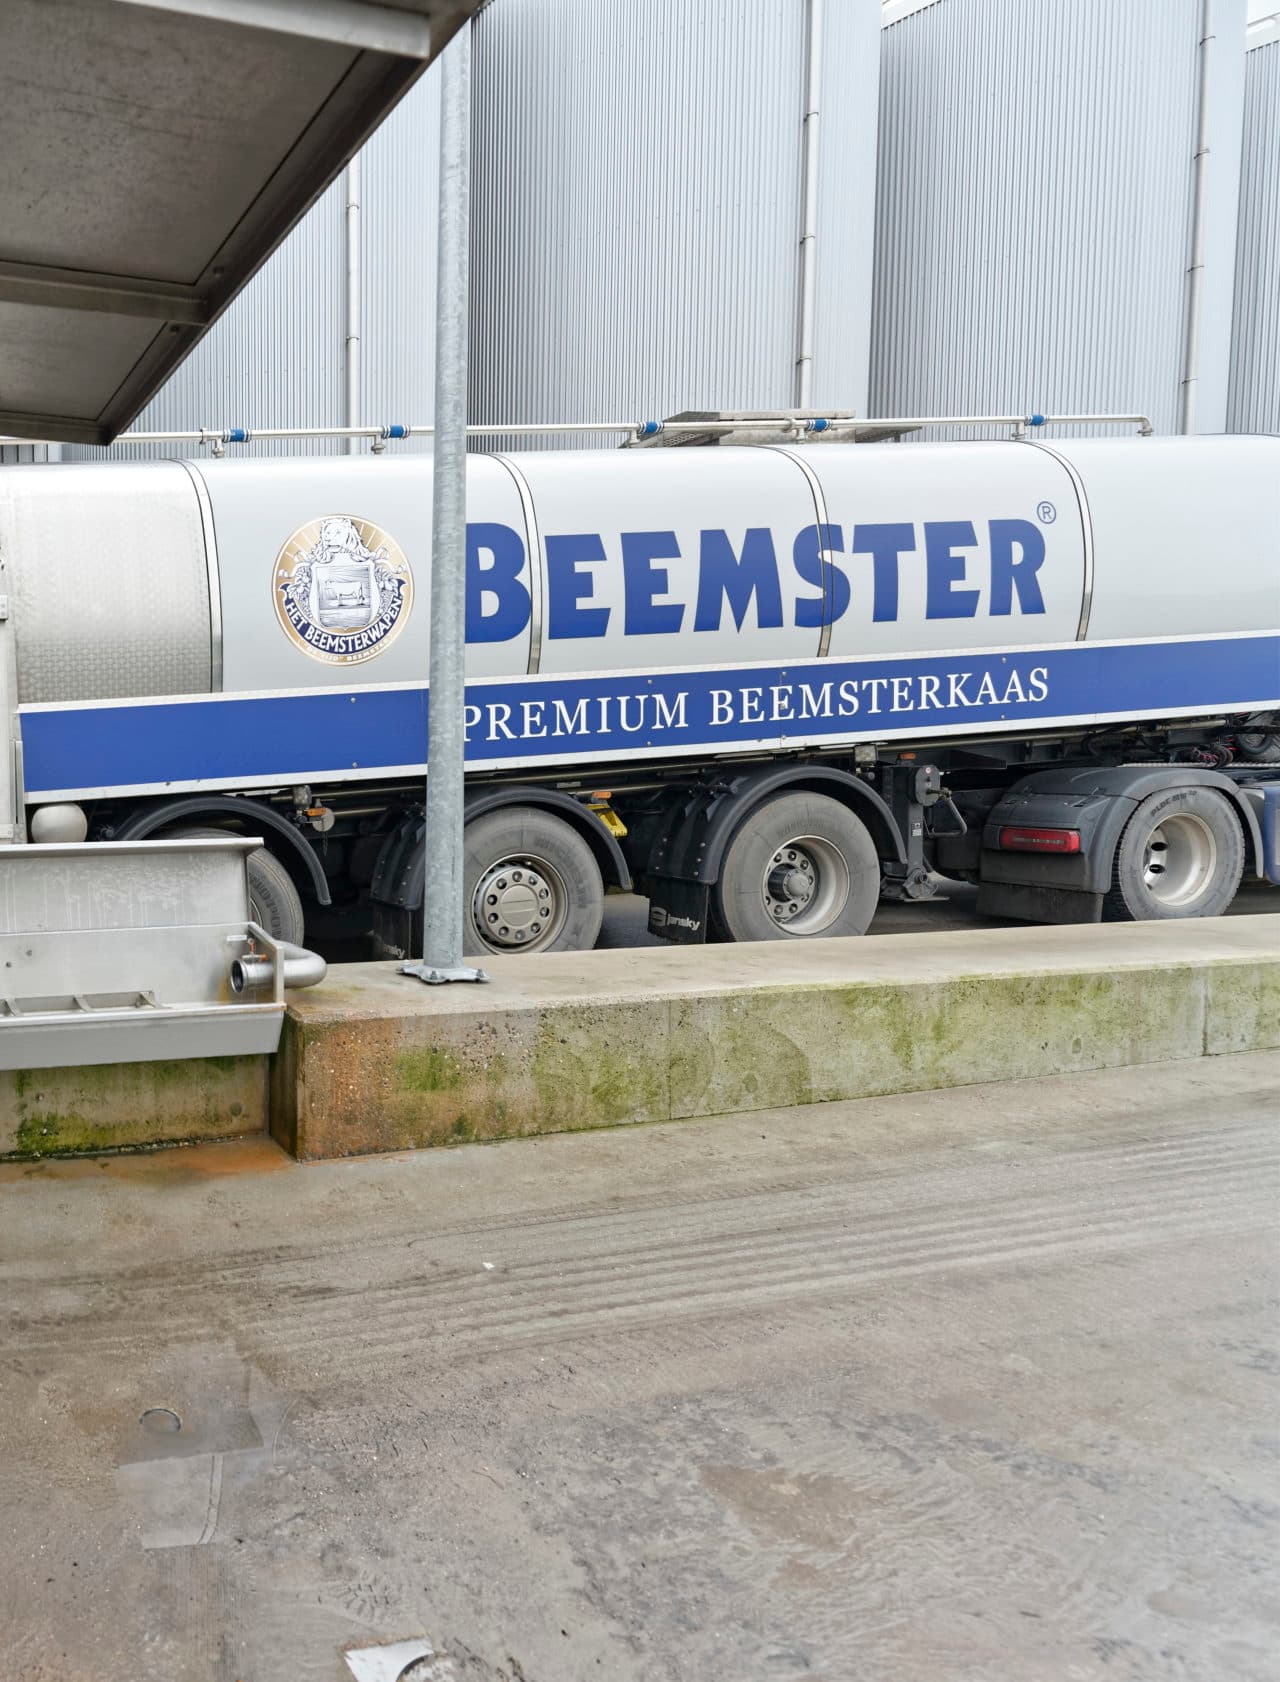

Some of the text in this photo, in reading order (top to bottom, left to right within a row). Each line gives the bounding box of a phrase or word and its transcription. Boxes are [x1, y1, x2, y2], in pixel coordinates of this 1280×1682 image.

[286, 602, 307, 630] HET
[463, 667, 1050, 742] PREMIUM BEEMSTERKAAS
